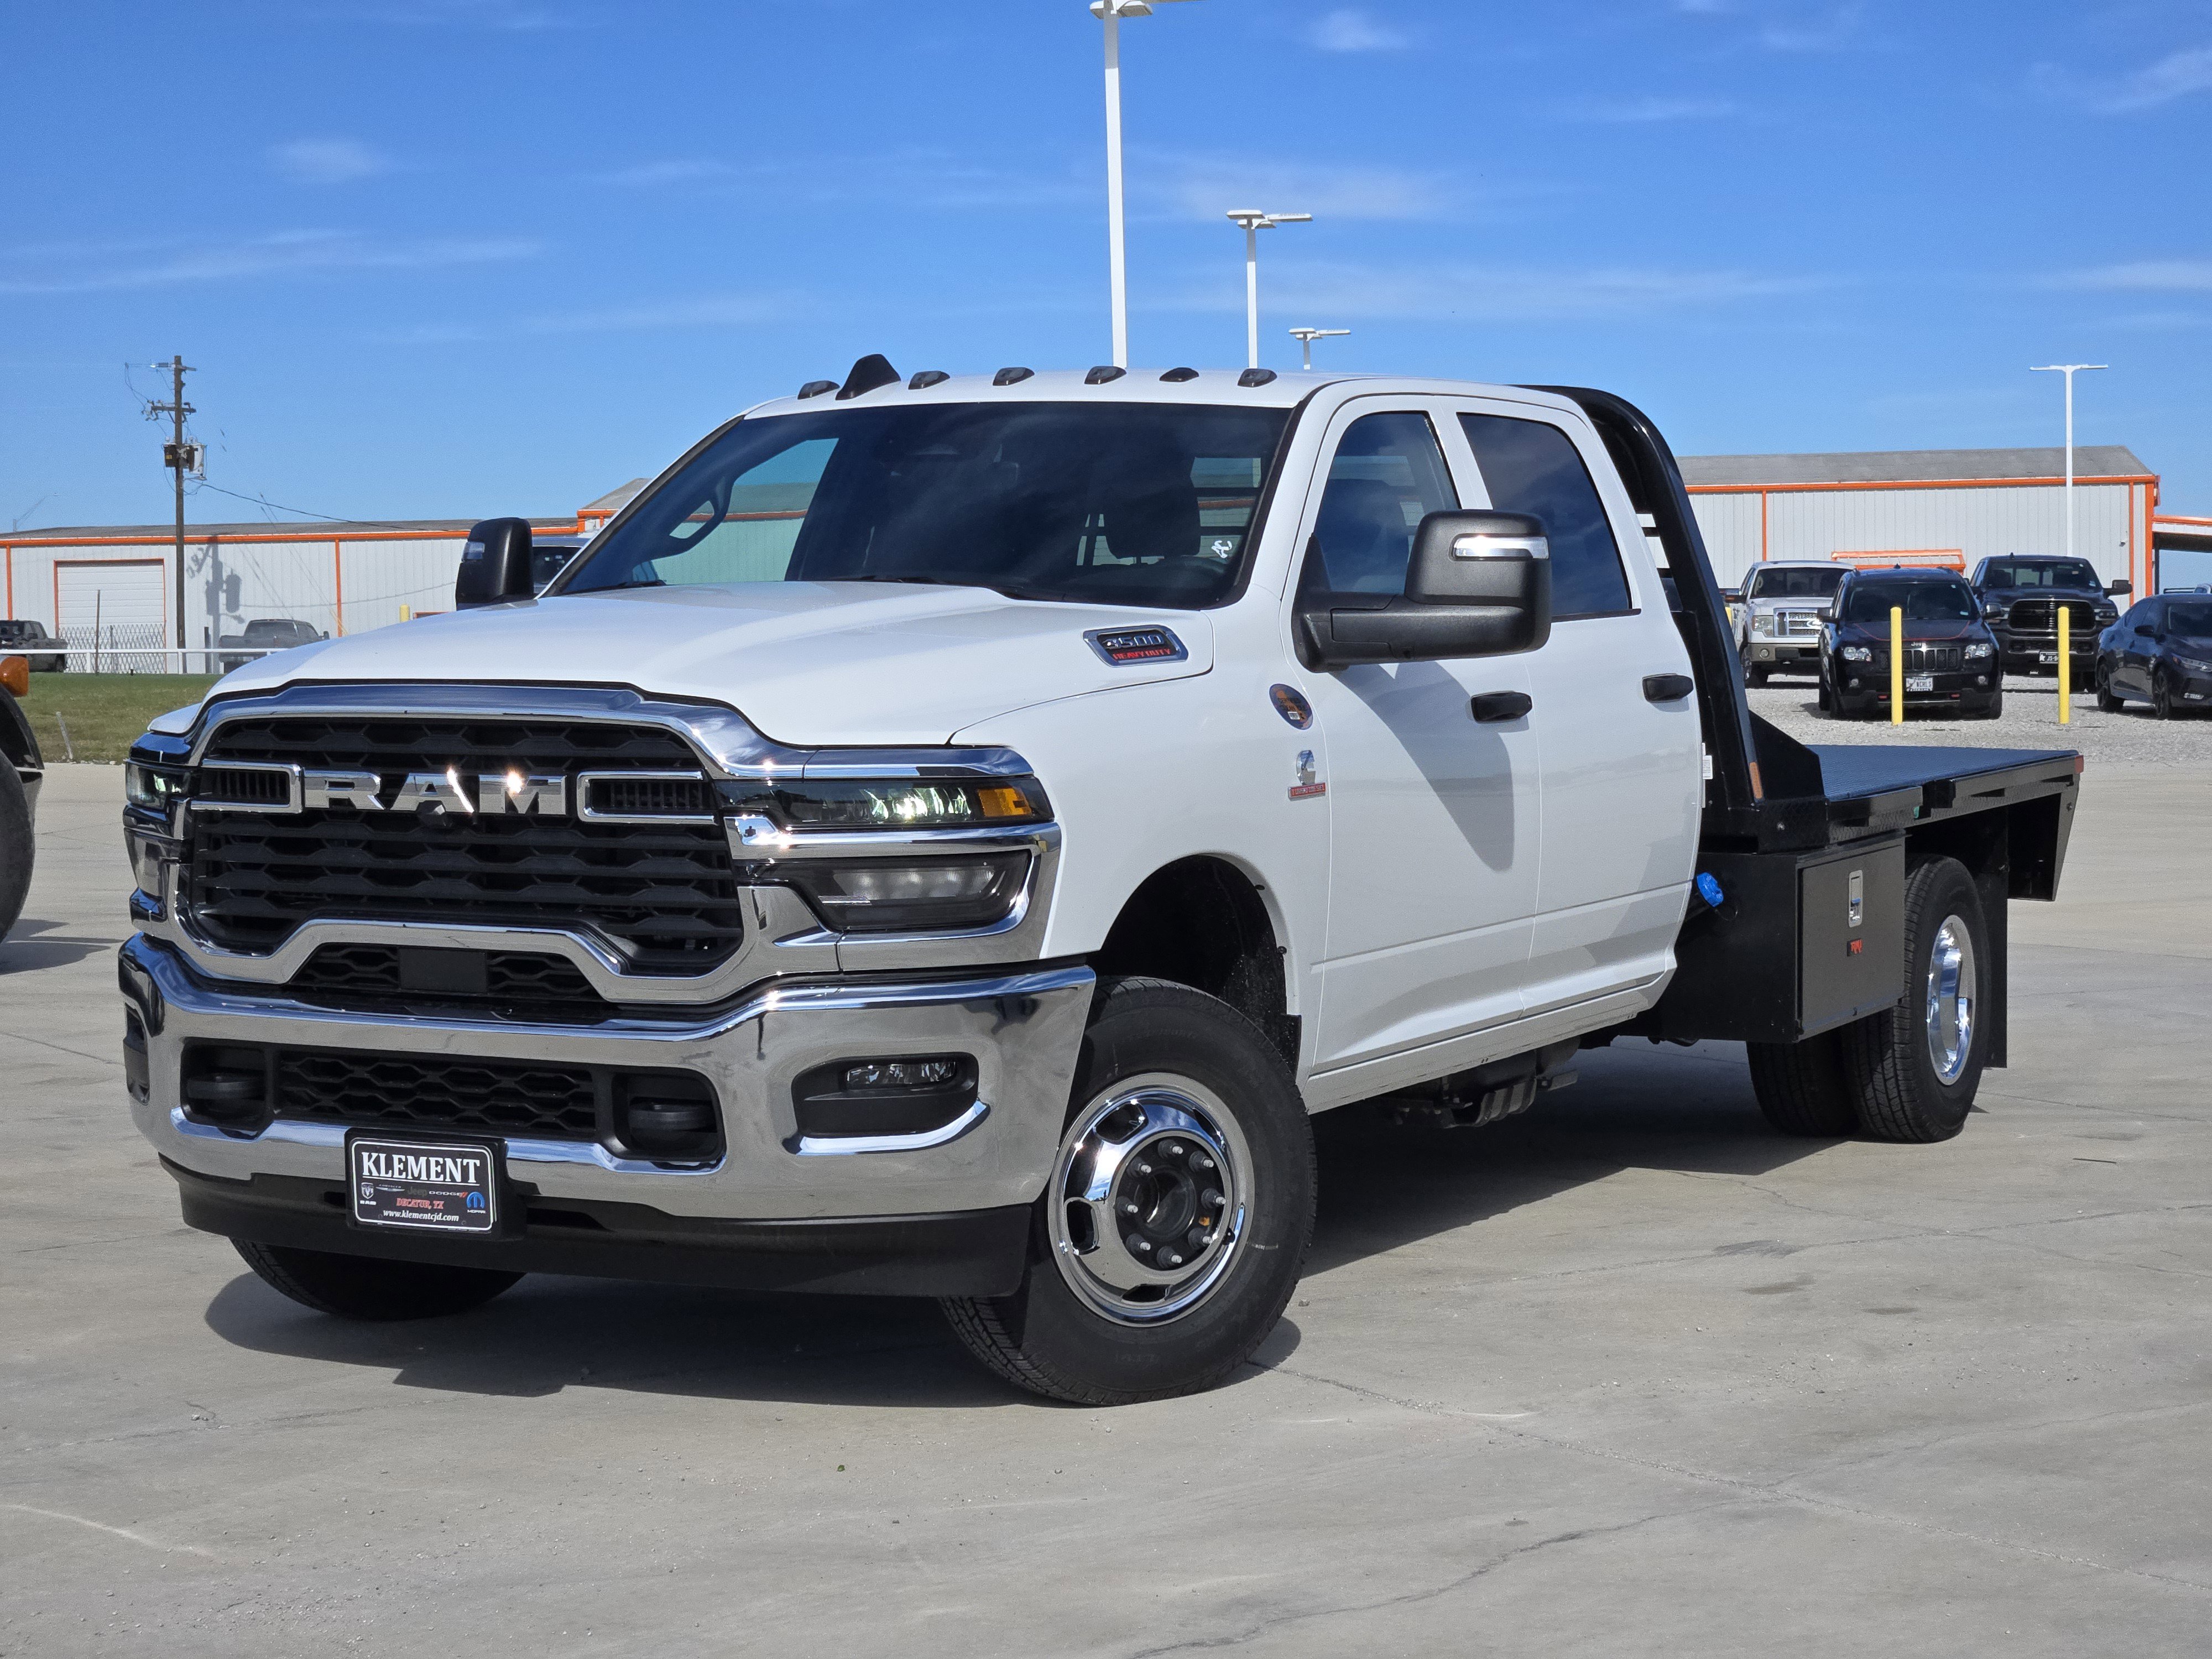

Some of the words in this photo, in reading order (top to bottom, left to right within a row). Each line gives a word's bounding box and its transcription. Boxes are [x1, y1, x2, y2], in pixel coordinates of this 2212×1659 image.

[304, 767, 566, 815] RAM
[362, 1152, 480, 1183] KLEMENT
[396, 1198, 431, 1210] DECATUR,
[433, 1201, 444, 1209] TX
[383, 1209, 459, 1222] www.klementcjd.com
